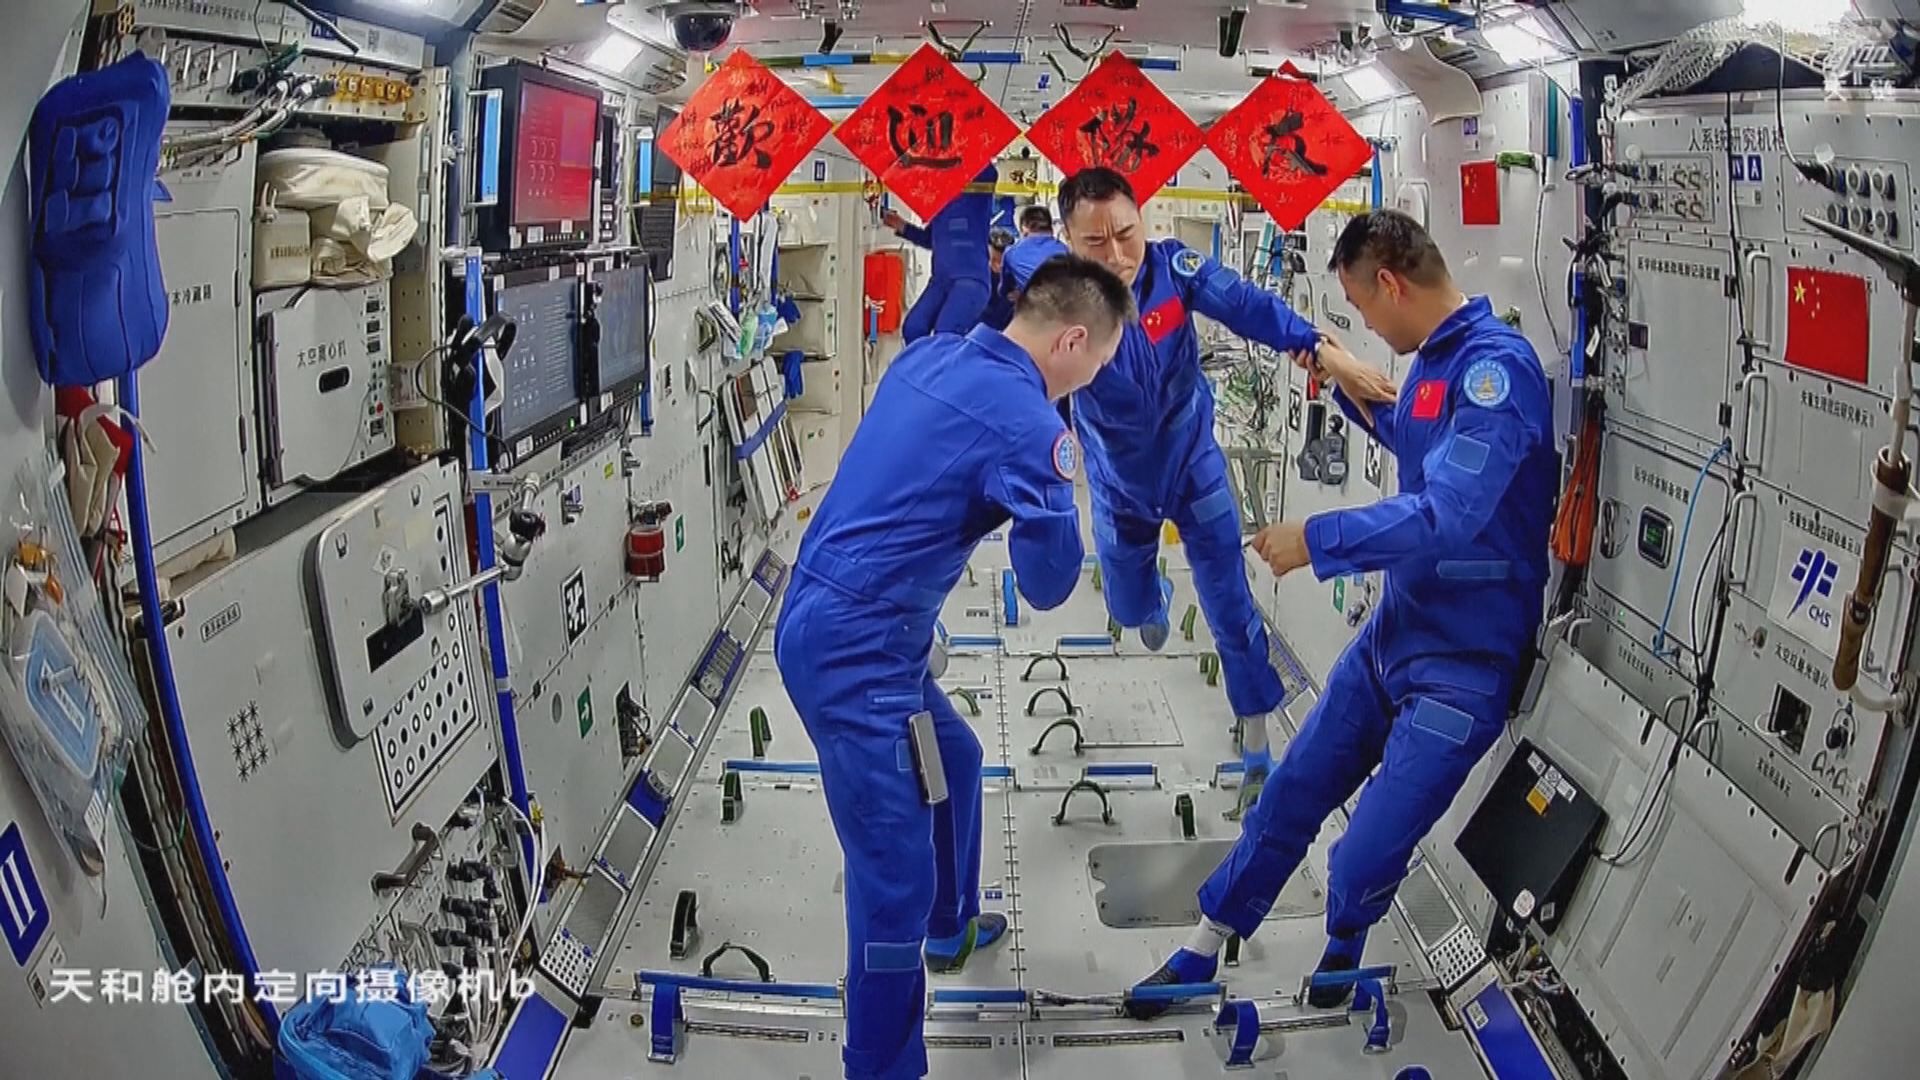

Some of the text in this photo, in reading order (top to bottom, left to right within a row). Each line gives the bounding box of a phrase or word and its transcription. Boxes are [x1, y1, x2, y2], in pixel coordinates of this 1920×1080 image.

[709, 98, 774, 169] 歡
[887, 104, 963, 168] 迎
[1808, 603, 1832, 628] CMS
